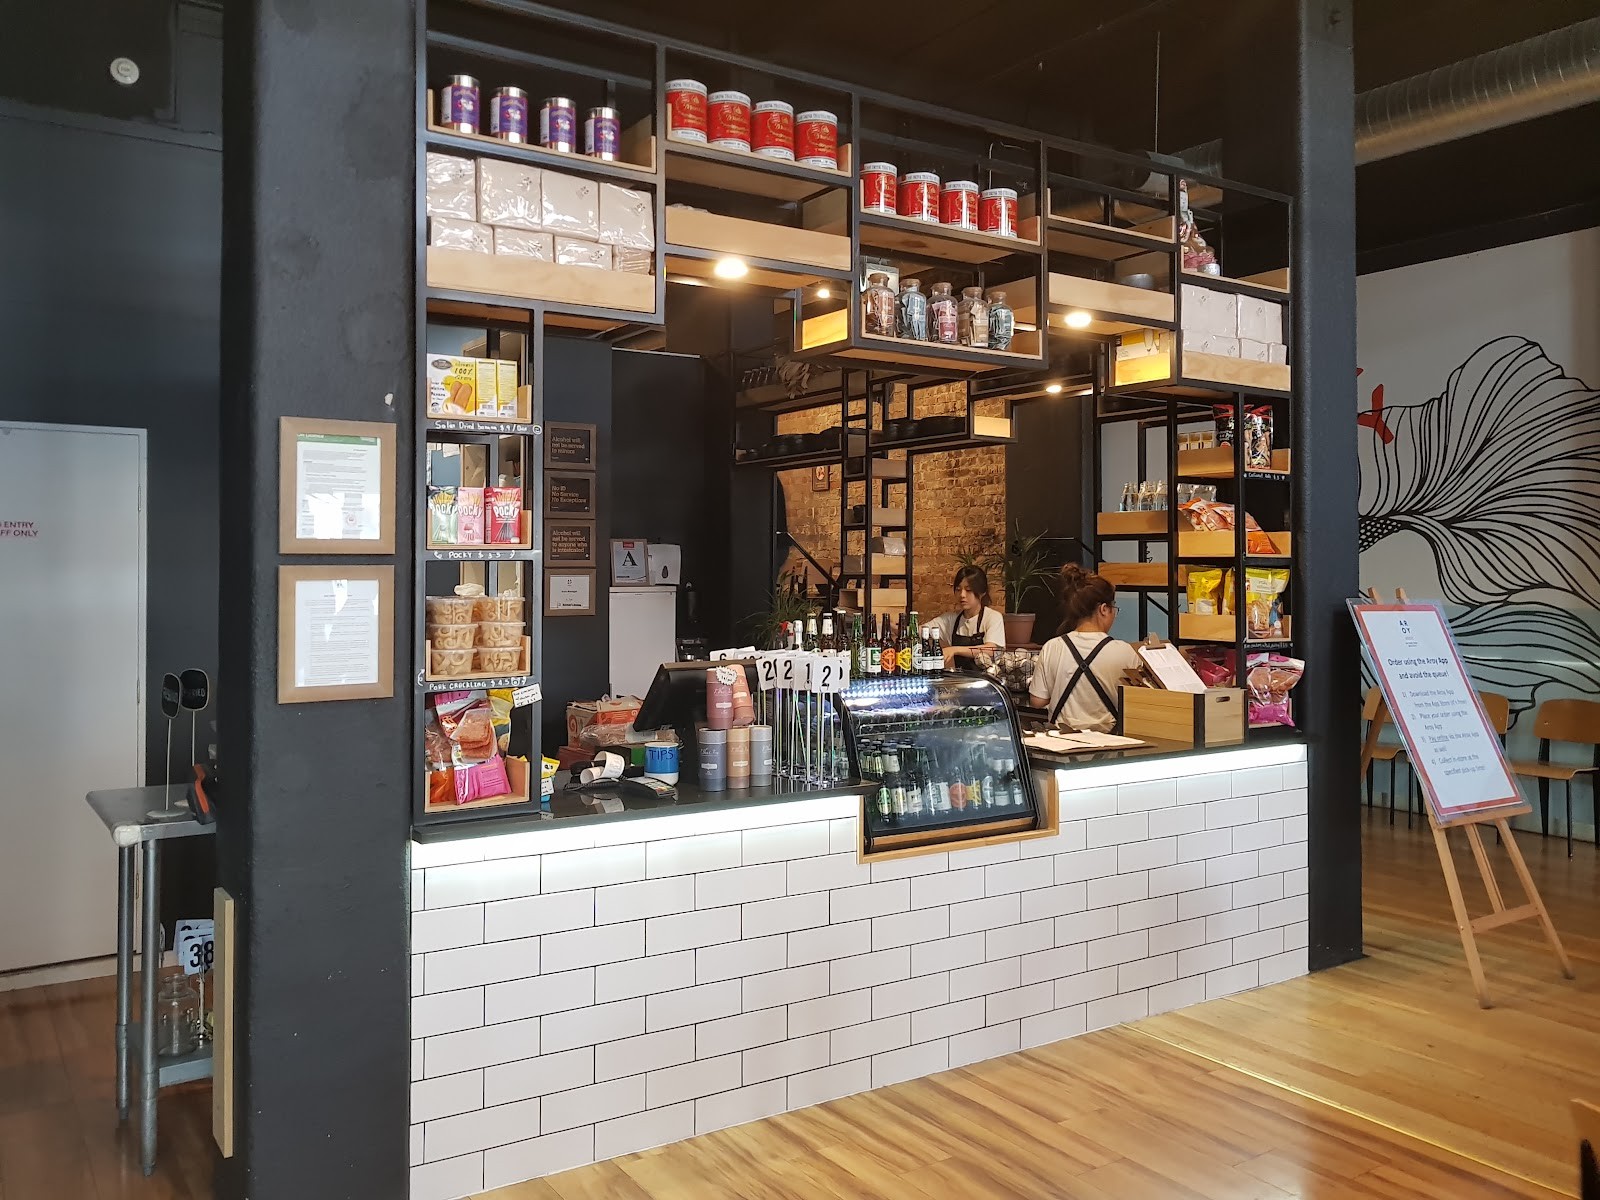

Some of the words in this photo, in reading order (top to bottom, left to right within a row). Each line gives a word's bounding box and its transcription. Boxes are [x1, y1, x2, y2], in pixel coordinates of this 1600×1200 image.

[458, 504, 483, 517] POCKY
[493, 504, 520, 519] POCKY
[449, 551, 472, 559] POCKY
[622, 551, 638, 566] A
[1388, 658, 1402, 666] Order
[822, 666, 831, 687] 2
[1409, 671, 1423, 679] avoid
[649, 750, 675, 761] TIPS
[190, 940, 213, 968] 38
